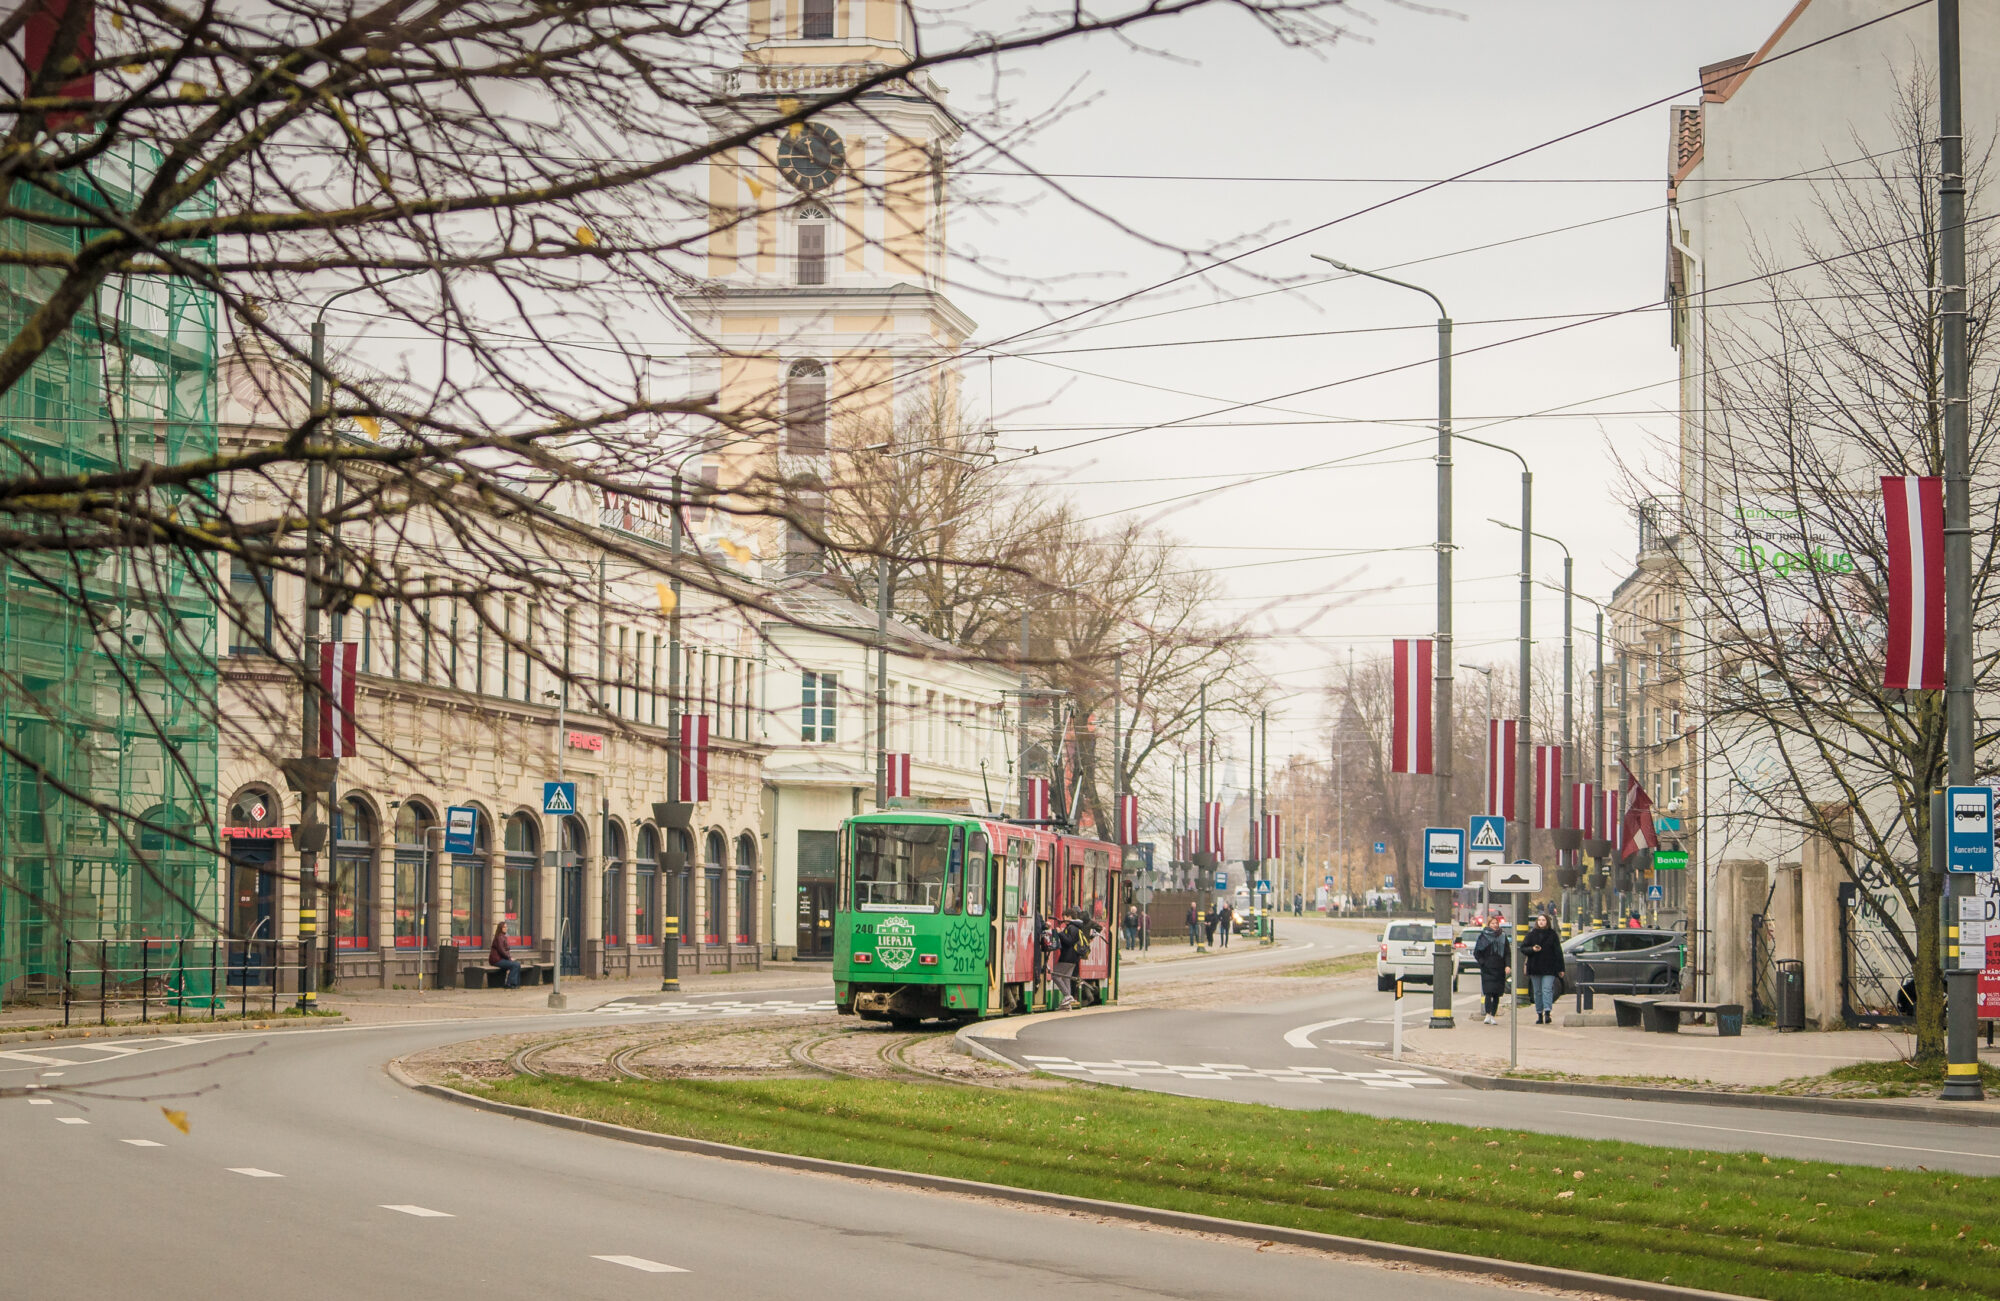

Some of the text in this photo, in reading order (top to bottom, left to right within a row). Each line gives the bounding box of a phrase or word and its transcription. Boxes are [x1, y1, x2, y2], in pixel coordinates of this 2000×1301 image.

[1735, 545, 1854, 577] 10 gadus
[855, 923, 874, 934] 240
[953, 957, 976, 973] 2014
